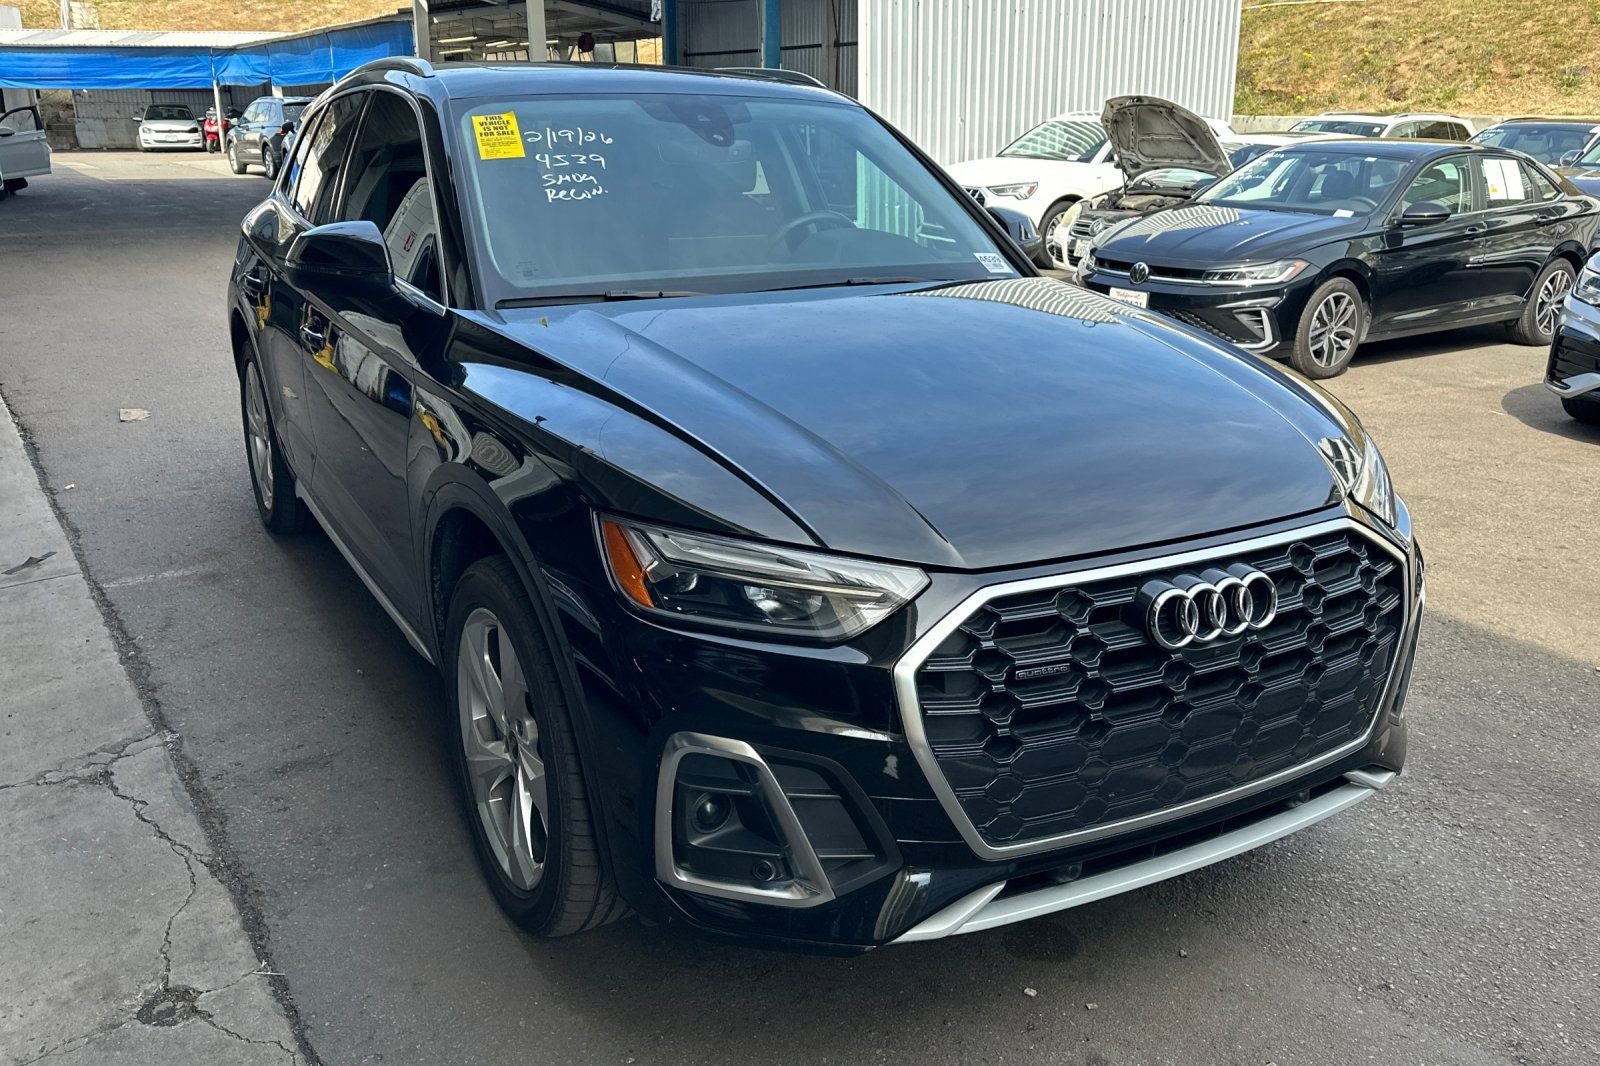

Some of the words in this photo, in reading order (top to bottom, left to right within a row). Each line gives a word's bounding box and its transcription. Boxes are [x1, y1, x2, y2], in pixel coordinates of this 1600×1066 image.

[523, 127, 613, 149] 2/19/26
[535, 153, 606, 170] 4539
[1017, 665, 1069, 680] quattro
